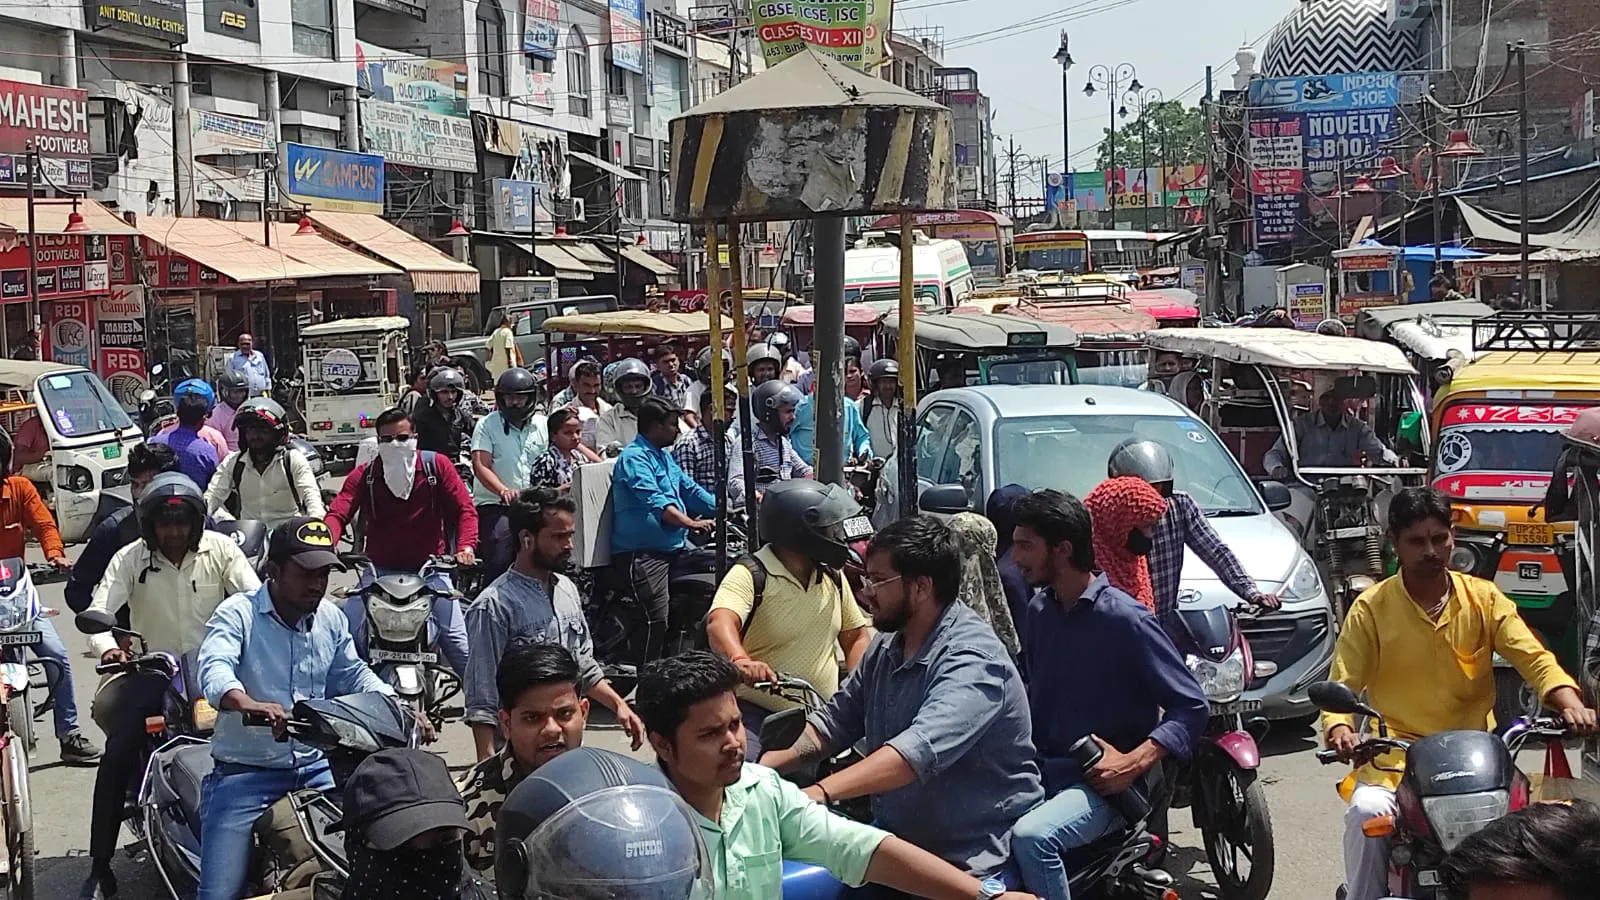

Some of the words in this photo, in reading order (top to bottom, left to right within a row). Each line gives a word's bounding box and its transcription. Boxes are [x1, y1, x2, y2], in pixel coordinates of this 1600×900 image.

[220, 11, 246, 29] ASUS
[758, 3, 798, 17] CBSE,
[800, 6, 832, 24] ICSE,
[836, 8, 858, 20] ISC
[117, 9, 142, 26] DENTAL
[143, 14, 160, 30] CARE
[161, 19, 185, 35] CENTRE
[816, 30, 829, 44] VI
[843, 31, 861, 45] XII
[766, 47, 784, 57] 463,
[785, 41, 806, 54] Biha
[413, 65, 439, 82] DIGITAL
[1351, 91, 1386, 106] SHOE
[0, 93, 88, 134] MAHESH
[1309, 114, 1389, 137] NOVELTY
[35, 135, 89, 155] FOOTWEAR
[418, 155, 432, 166] CIVIL
[322, 160, 377, 191] CAMPUS
[36, 249, 80, 263] OOTWEAR
[3, 282, 25, 294] Campus
[55, 304, 82, 318] RED
[101, 301, 141, 317] Campus
[107, 352, 142, 370] RED
[1521, 568, 1539, 578] RE
